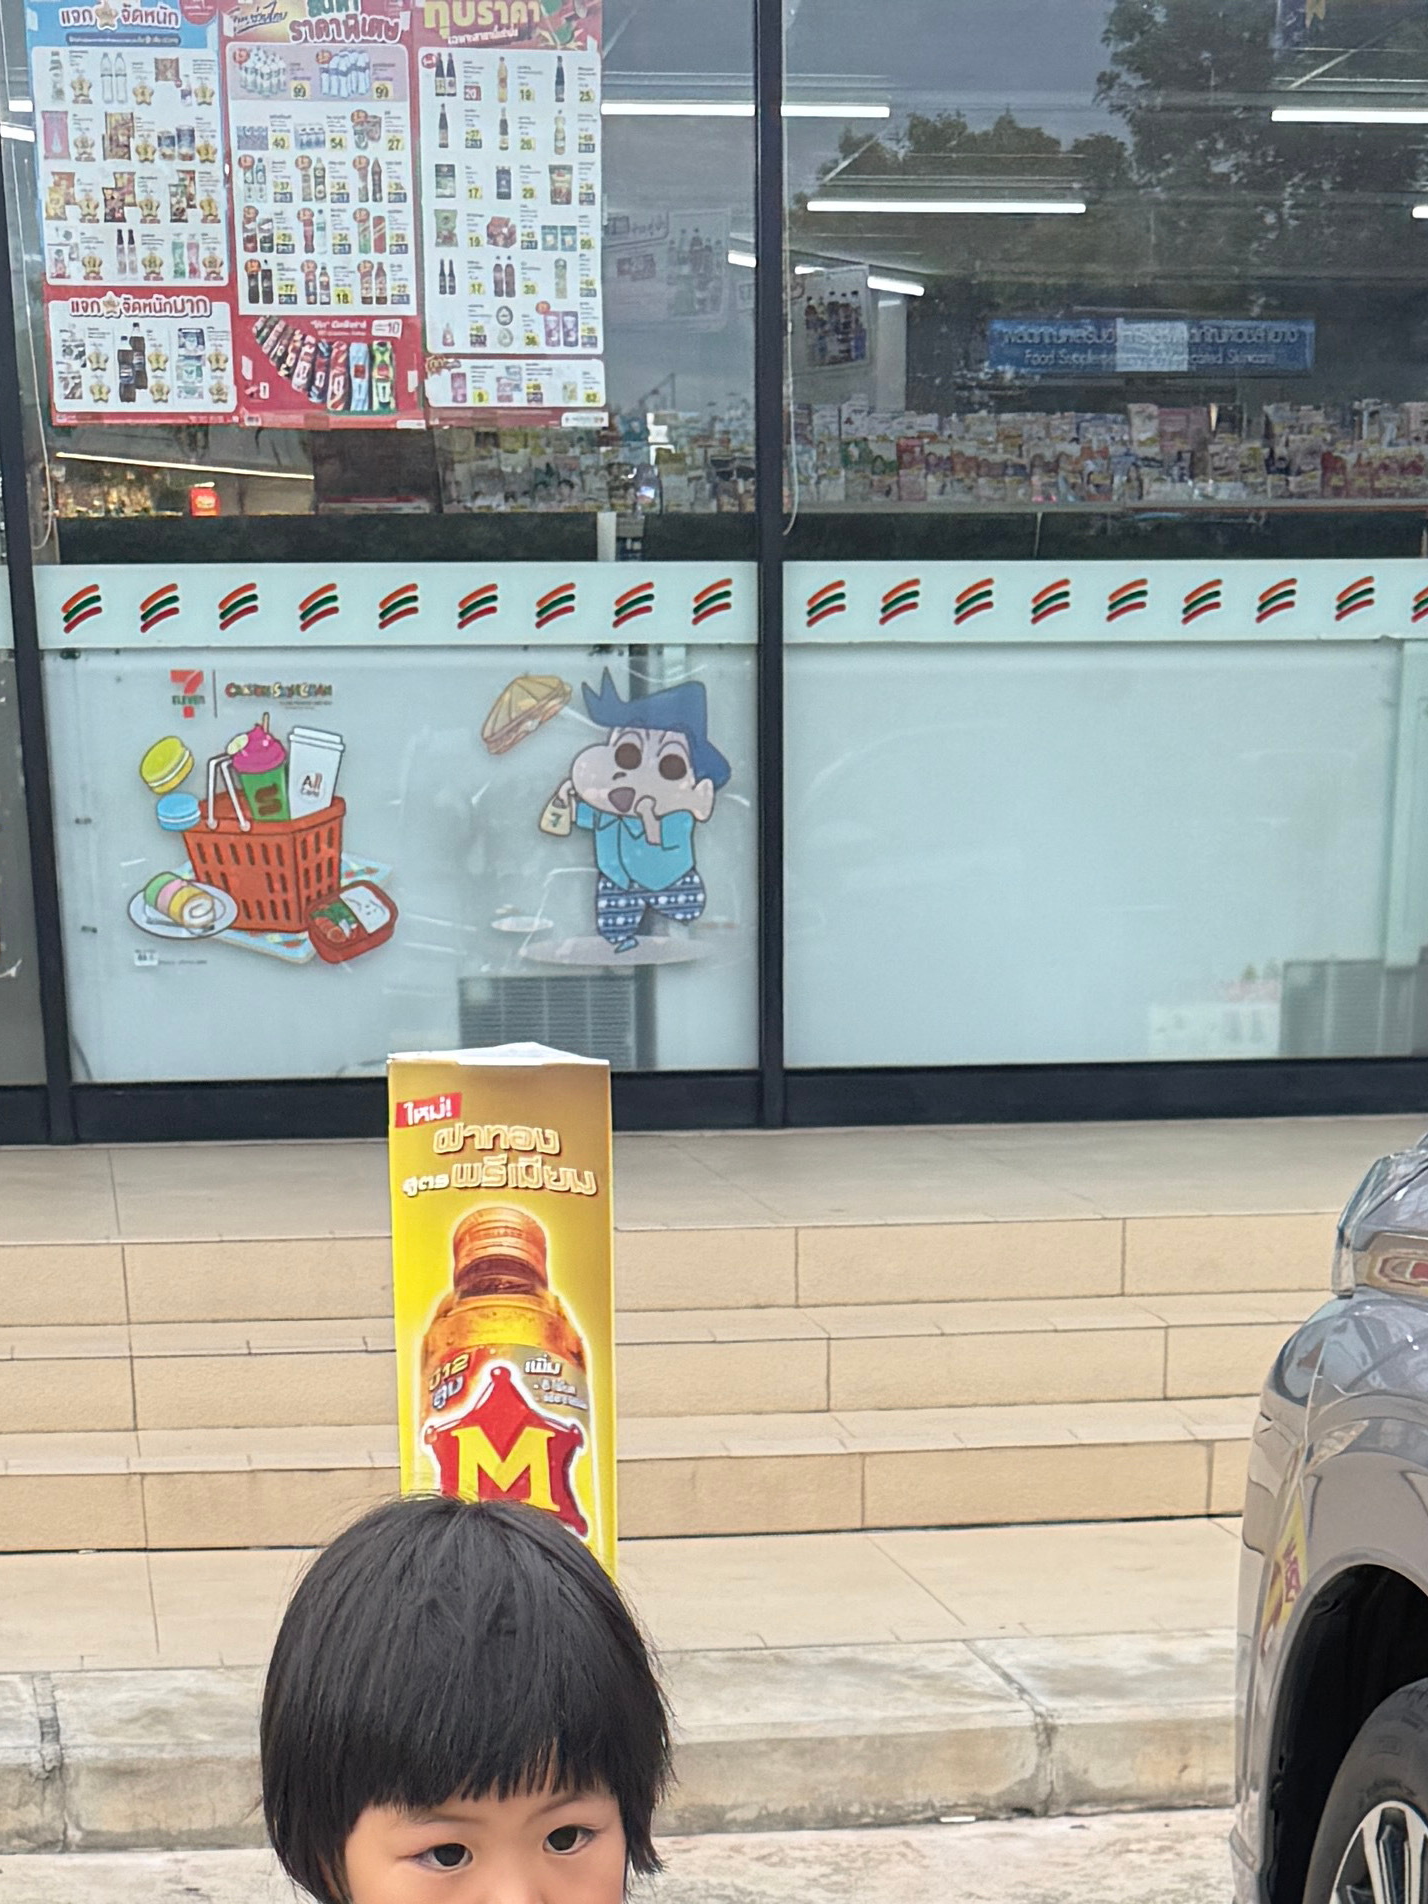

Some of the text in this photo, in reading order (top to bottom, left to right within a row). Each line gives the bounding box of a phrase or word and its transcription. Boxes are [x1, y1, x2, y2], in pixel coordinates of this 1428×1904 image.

[170, 669, 204, 695] 7
[403, 1096, 453, 1125] ใหม่!
[449, 1425, 561, 1512] M
